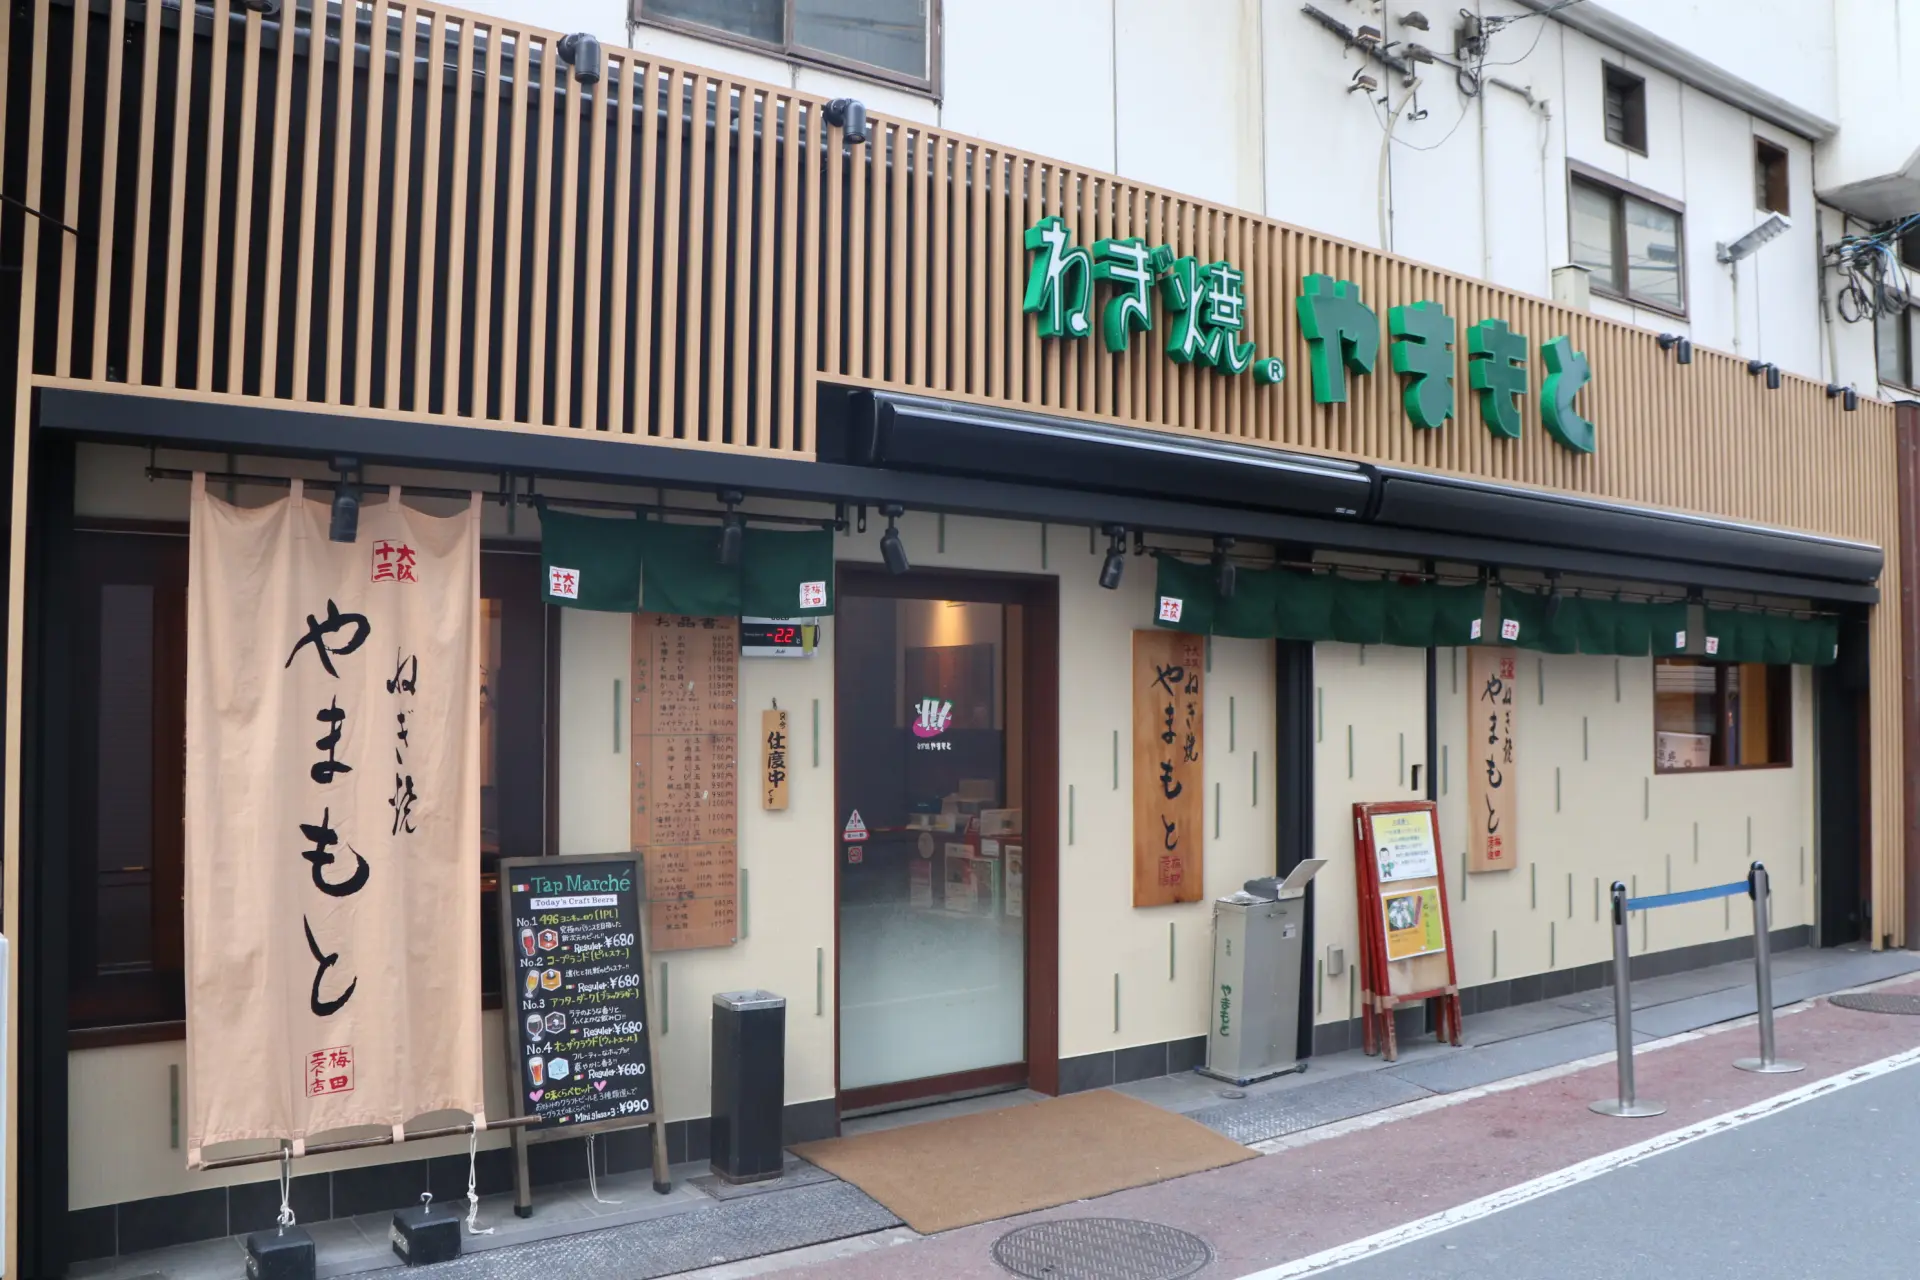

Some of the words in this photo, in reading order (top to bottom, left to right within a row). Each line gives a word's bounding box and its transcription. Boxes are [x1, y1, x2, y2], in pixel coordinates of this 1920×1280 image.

[1025, 215, 1256, 375] ねぎ焼
[1296, 272, 1595, 454] やまもと
[767, 731, 786, 788] 仕度中
[1151, 663, 1184, 850] やまもと
[1481, 673, 1502, 833] やまもと
[284, 598, 371, 1017] やまもと
[531, 876, 563, 895] Tap
[565, 869, 631, 892] Marché
[535, 898, 567, 907] Today's
[592, 896, 614, 904] Beers
[516, 916, 538, 927] No.1
[520, 957, 544, 968] No.2
[522, 999, 546, 1010] No.3
[526, 1041, 553, 1055] No.4
[544, 1083, 594, 1100] 味くらべセット
[619, 1098, 649, 1114] ¥990
